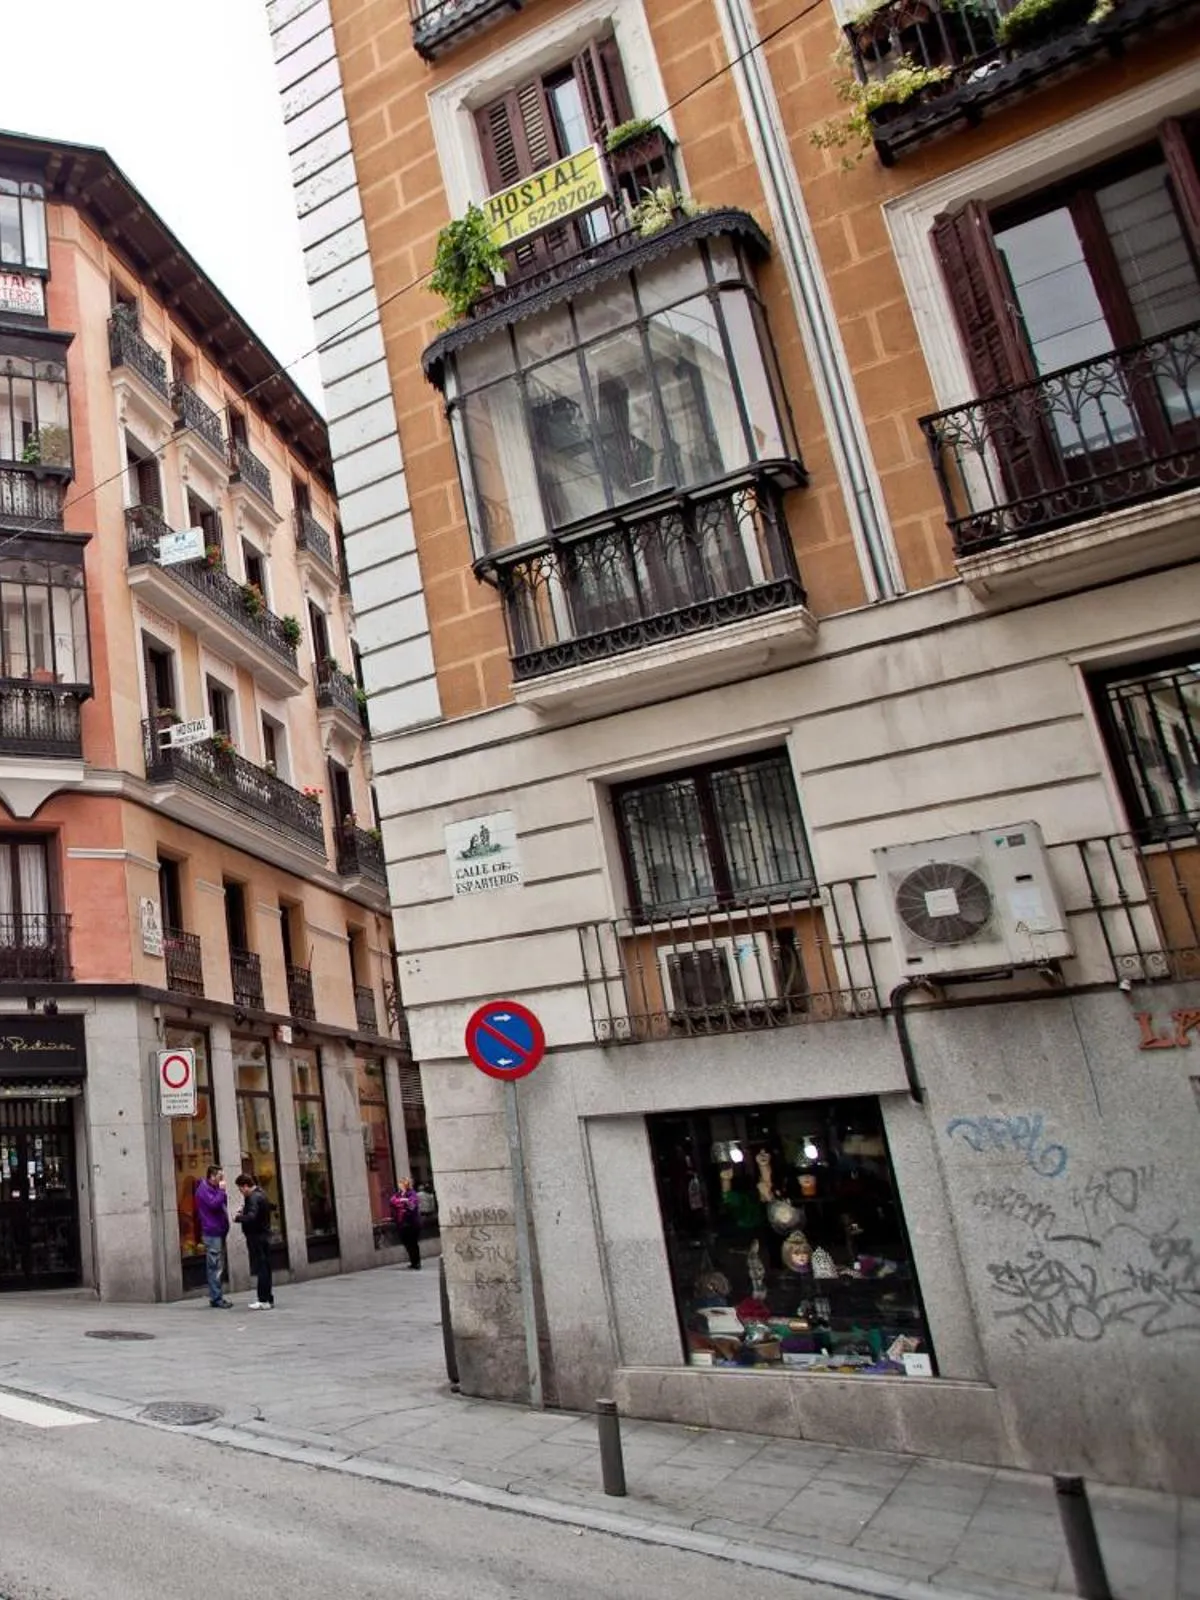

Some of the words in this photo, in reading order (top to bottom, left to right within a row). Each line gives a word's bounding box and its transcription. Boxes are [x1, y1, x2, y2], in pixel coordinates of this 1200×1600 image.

[491, 161, 589, 223] HOSTAL
[176, 719, 206, 736] HOSTAL
[456, 864, 489, 880] CALLE
[456, 872, 519, 894] ESPARTEROS
